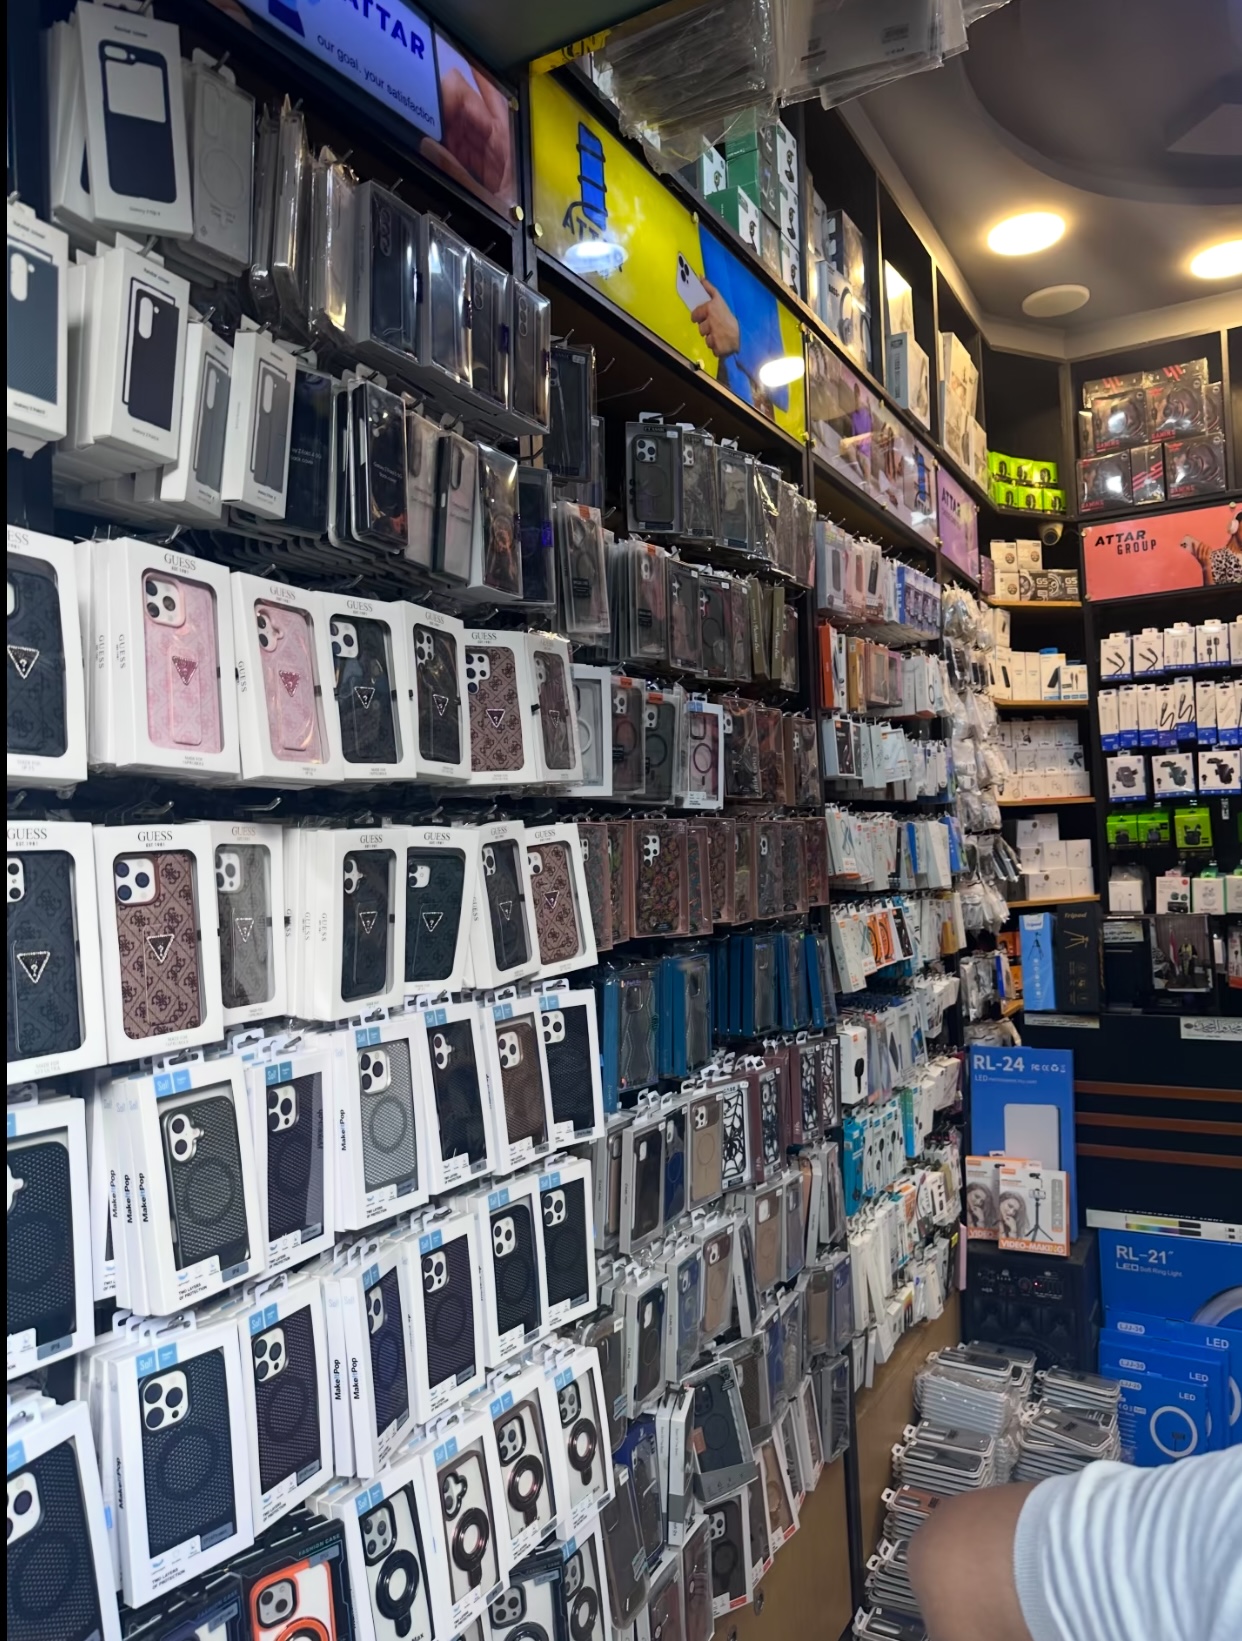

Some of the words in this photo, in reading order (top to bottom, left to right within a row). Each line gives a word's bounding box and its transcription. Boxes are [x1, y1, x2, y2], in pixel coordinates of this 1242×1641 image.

[317, 34, 334, 53] our
[364, 67, 385, 89] your
[387, 84, 436, 127] satisfaction
[7, 529, 30, 546] ESS
[1095, 530, 1146, 546] ATTAR
[1117, 539, 1157, 555] GROUP
[164, 553, 196, 571] GUESS
[270, 585, 296, 600] GUESS
[346, 600, 373, 612] GUESS
[425, 611, 445, 624] GUESS
[471, 632, 497, 641] GUESS
[118, 633, 126, 669] GUESS
[238, 660, 248, 693] GUESS
[7, 828, 48, 840] GUESS
[137, 831, 173, 842] GUESS
[232, 826, 256, 836] GUESS
[423, 832, 451, 841] GUESS
[491, 826, 508, 836] GUESS
[534, 829, 556, 839] GUESS
[360, 834, 383, 844] GUESS
[471, 896, 479, 922] GUESS
[973, 1054, 1025, 1072] RL-24
[974, 1074, 988, 1082] LED
[124, 1174, 133, 1223] MakeItPop
[139, 1172, 149, 1222] MakeItPop
[1116, 1261, 1139, 1272] LED
[1152, 1267, 1167, 1276] Ring
[1167, 1269, 1183, 1278] Light
[183, 1285, 207, 1299] PROTECTION
[188, 1282, 202, 1291] LAYERS
[1206, 1336, 1229, 1349] LED
[333, 1359, 342, 1400] MakeItPop
[351, 1357, 360, 1400] MakeItPop
[1189, 1371, 1209, 1382] LED
[1178, 1391, 1196, 1401] LED
[298, 1541, 324, 1556] FASHION
[325, 1533, 340, 1544] CASE
[152, 1576, 161, 1584] TWO
[161, 1568, 178, 1579] LAYERS
[158, 1569, 185, 1587] PROTECTION
